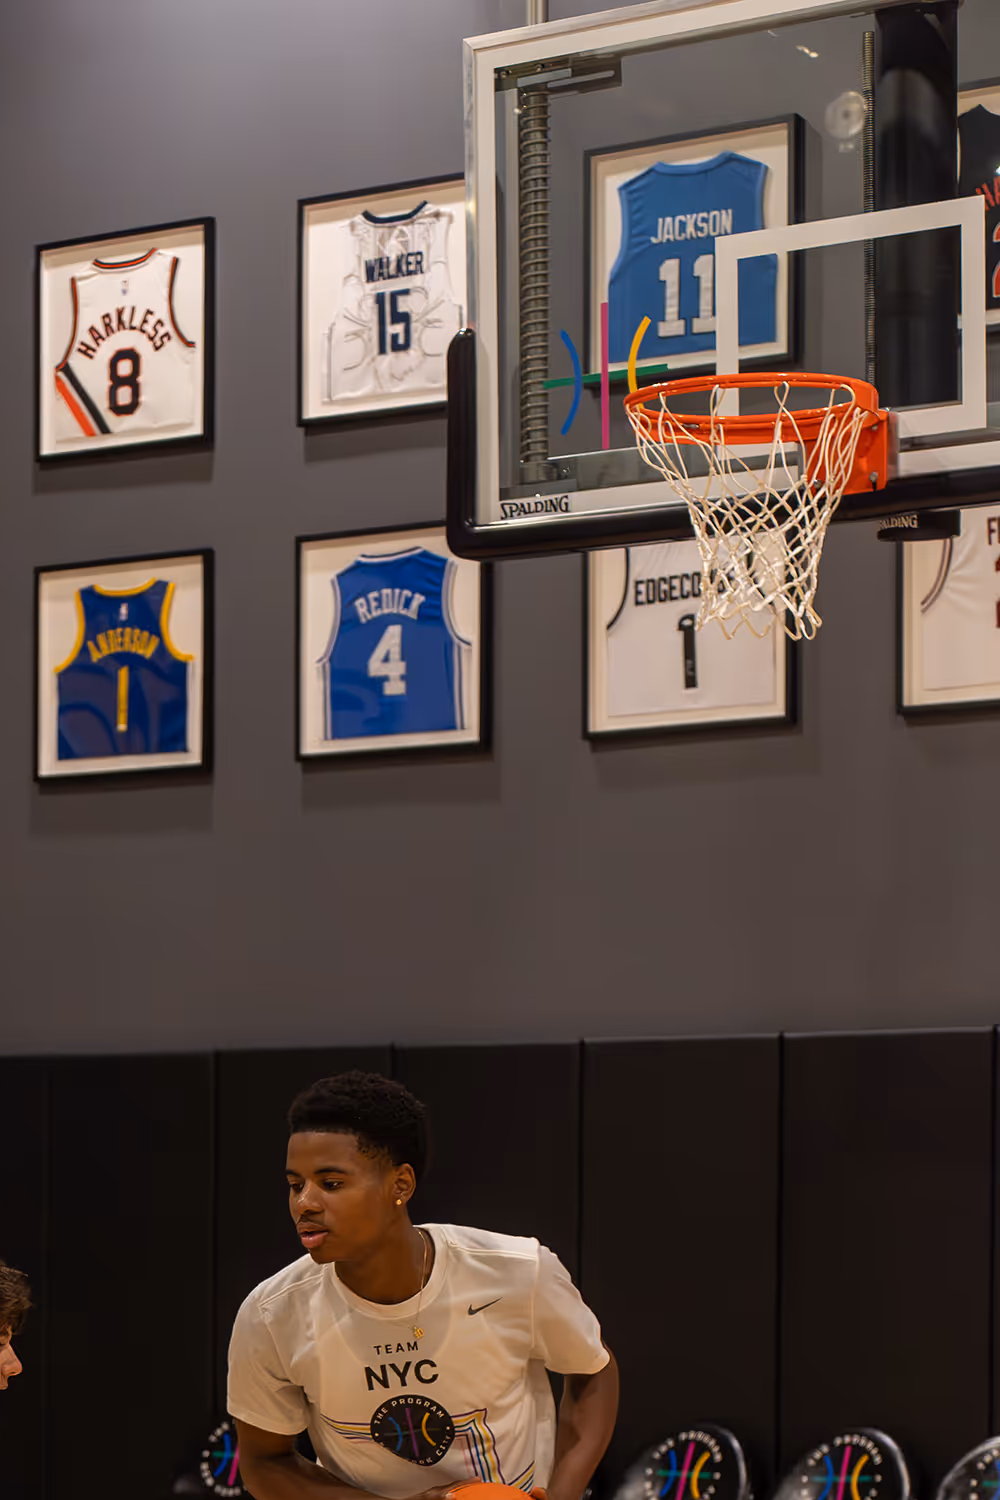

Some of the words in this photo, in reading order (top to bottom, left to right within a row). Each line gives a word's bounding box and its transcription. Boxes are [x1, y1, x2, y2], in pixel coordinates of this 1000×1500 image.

[650, 208, 733, 243] JACKSON
[365, 251, 425, 283] WALKER
[657, 253, 716, 338] 11
[76, 305, 172, 360] HARKLESS
[376, 288, 411, 355] 15
[108, 346, 142, 417] 8
[500, 495, 570, 520] SPALDING
[635, 567, 738, 606] EDGECO
[354, 588, 426, 624] REDICK
[87, 627, 160, 663] ANDERSON
[367, 624, 407, 696] 4
[677, 613, 698, 689] 1
[117, 665, 130, 732] 1
[373, 1341, 420, 1356] TEAM
[364, 1358, 440, 1392] NYC
[373, 1407, 388, 1425] THE
[391, 1397, 445, 1419] PROGRAM
